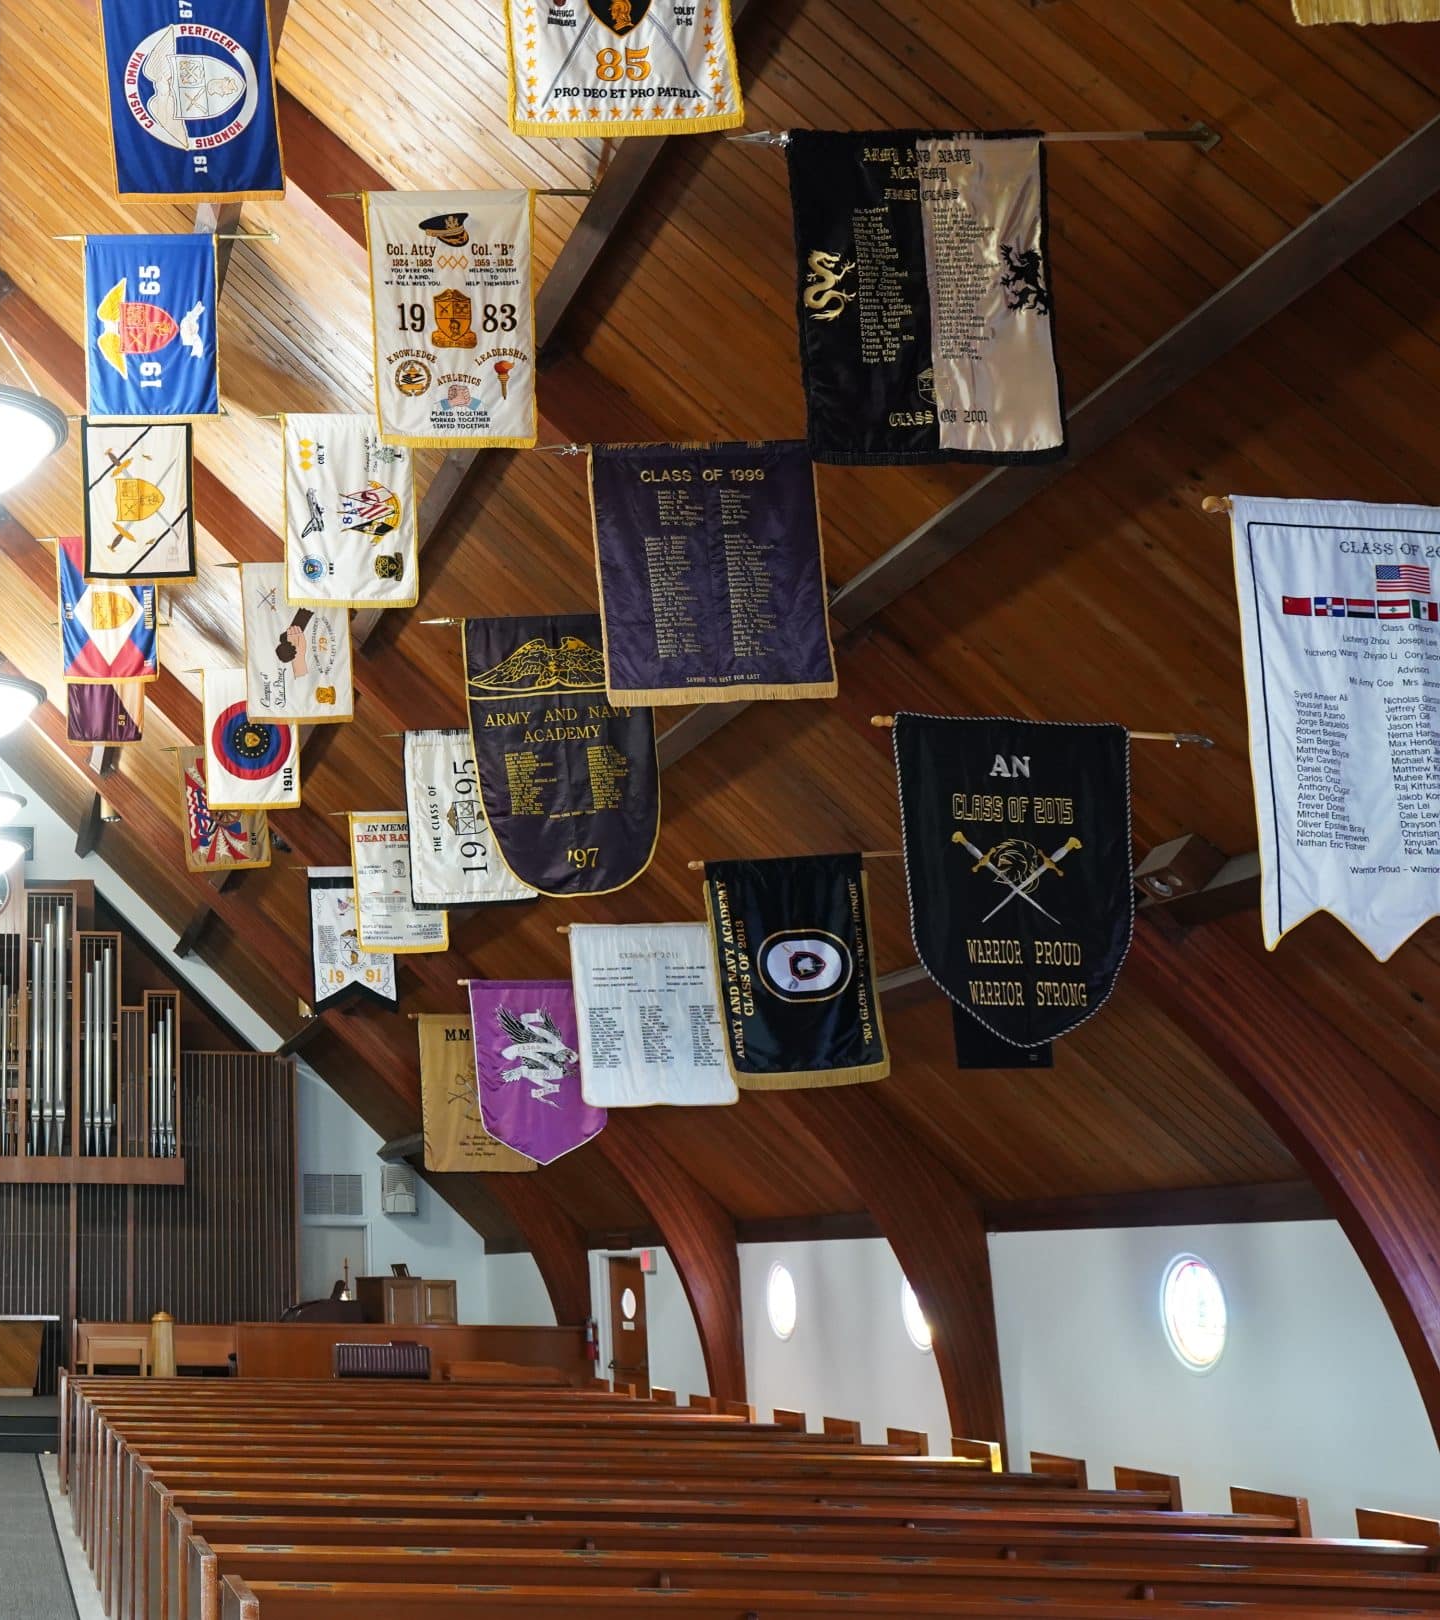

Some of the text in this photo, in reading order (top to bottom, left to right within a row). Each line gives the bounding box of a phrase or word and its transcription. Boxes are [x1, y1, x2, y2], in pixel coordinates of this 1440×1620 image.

[674, 6, 695, 16] COLBY
[180, 26, 240, 53] PERFICERE
[596, 46, 651, 81] 85
[127, 51, 155, 129] CAUSA OMNIA
[554, 87, 701, 98] PRO DEO ET PRO PATRIA
[195, 121, 243, 148] HONORIS
[194, 156, 207, 172] 19
[387, 243, 436, 257] Col. Atty
[472, 243, 514, 255] Col. "B"
[398, 303, 517, 332] 19 83
[139, 265, 162, 388] 19 65
[386, 350, 437, 364] KNOWLEDGE
[475, 348, 528, 366] LEADERSHIP
[437, 373, 481, 386] ATHLETICS
[963, 410, 988, 423] 2001
[640, 469, 765, 482] CLASS OF 1999
[1340, 542, 1419, 556] CLASS OF
[319, 637, 327, 652] 79
[1304, 649, 1337, 658] Yucheng
[1384, 696, 1419, 704] Nicholas
[485, 705, 633, 727] ARMY AND NAVY
[524, 725, 600, 743] ACADEMY
[1296, 746, 1330, 755] Matthew
[989, 754, 1031, 778] AN
[1392, 757, 1424, 765] Michael
[284, 768, 292, 791] 1910
[1297, 774, 1322, 782] Carlos
[1298, 783, 1331, 793] Anthony
[952, 793, 1074, 825] CLASS OF 2015
[428, 786, 442, 851] THE CLASS OF
[454, 759, 488, 875] 19 95
[1297, 820, 1321, 828] Oliver
[357, 834, 386, 842] DEAN
[1297, 830, 1332, 838] Nicholas
[1297, 839, 1327, 847] Nathan
[567, 848, 599, 868] '97
[967, 939, 1081, 966] WARRIOR PROUD
[716, 881, 745, 1059] ARMY AND NAVY ACADEMY
[735, 920, 754, 1016] CLASS OF 2013
[328, 969, 382, 983] 19 91
[969, 980, 1087, 1007] WARRIOR STRONG
[858, 988, 869, 1020] GLORY
